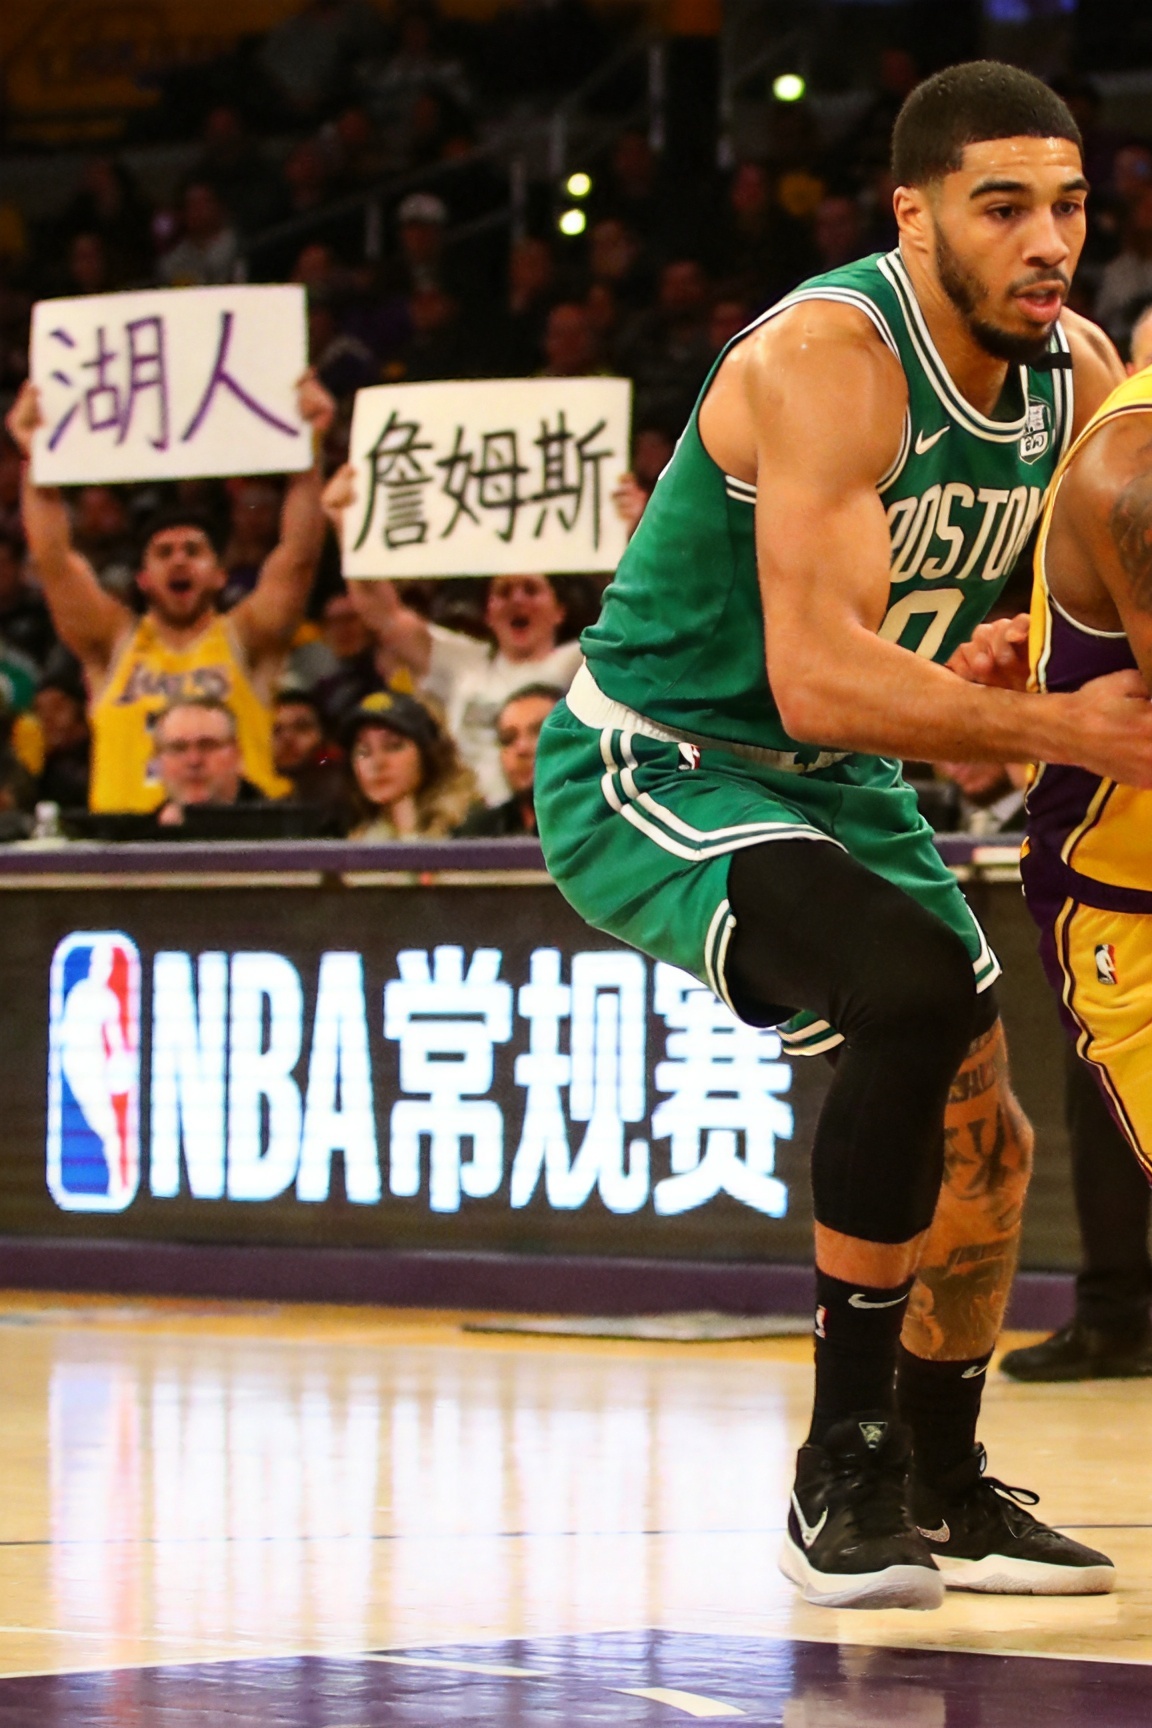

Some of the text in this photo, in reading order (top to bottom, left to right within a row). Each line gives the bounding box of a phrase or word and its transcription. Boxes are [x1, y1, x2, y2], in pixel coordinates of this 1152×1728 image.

[48, 311, 300, 452] 湖人
[352, 409, 615, 553] 詹姆斯
[147, 943, 796, 1219] NBA常规赛
